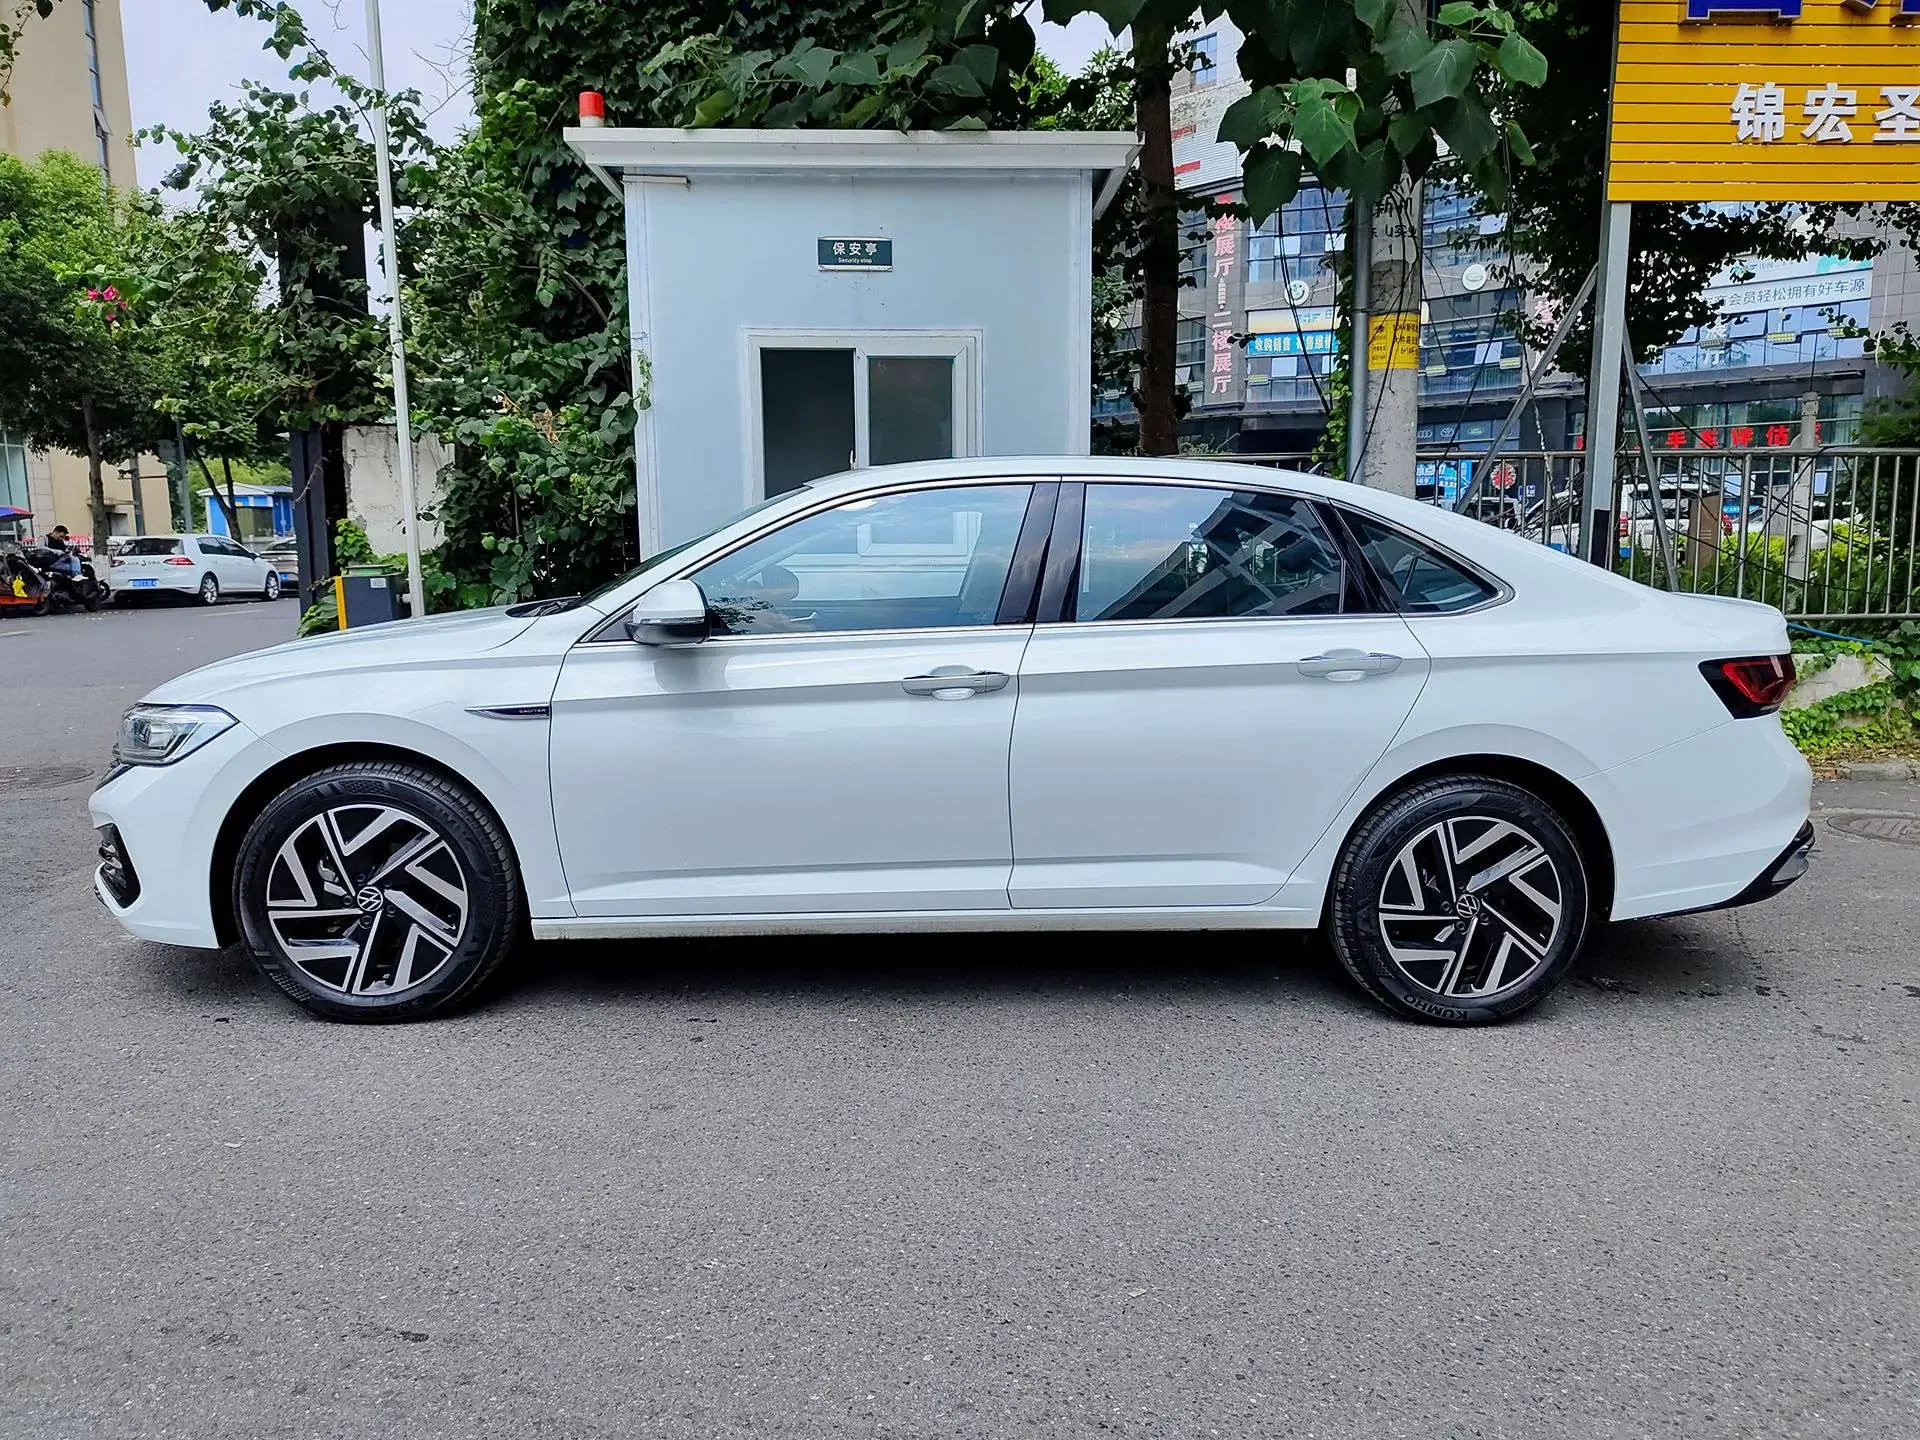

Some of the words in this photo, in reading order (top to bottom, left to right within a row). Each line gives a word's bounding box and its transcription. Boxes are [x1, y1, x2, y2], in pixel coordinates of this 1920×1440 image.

[1730, 82, 1920, 144] 锦宏圣
[832, 241, 878, 256] 保安亭
[1214, 194, 1234, 277] 楼展厅
[1705, 277, 1866, 308] 会员轻松拥有好车源
[1211, 311, 1232, 394] 二楼展厅
[1403, 994, 1469, 1020] KUMHO
